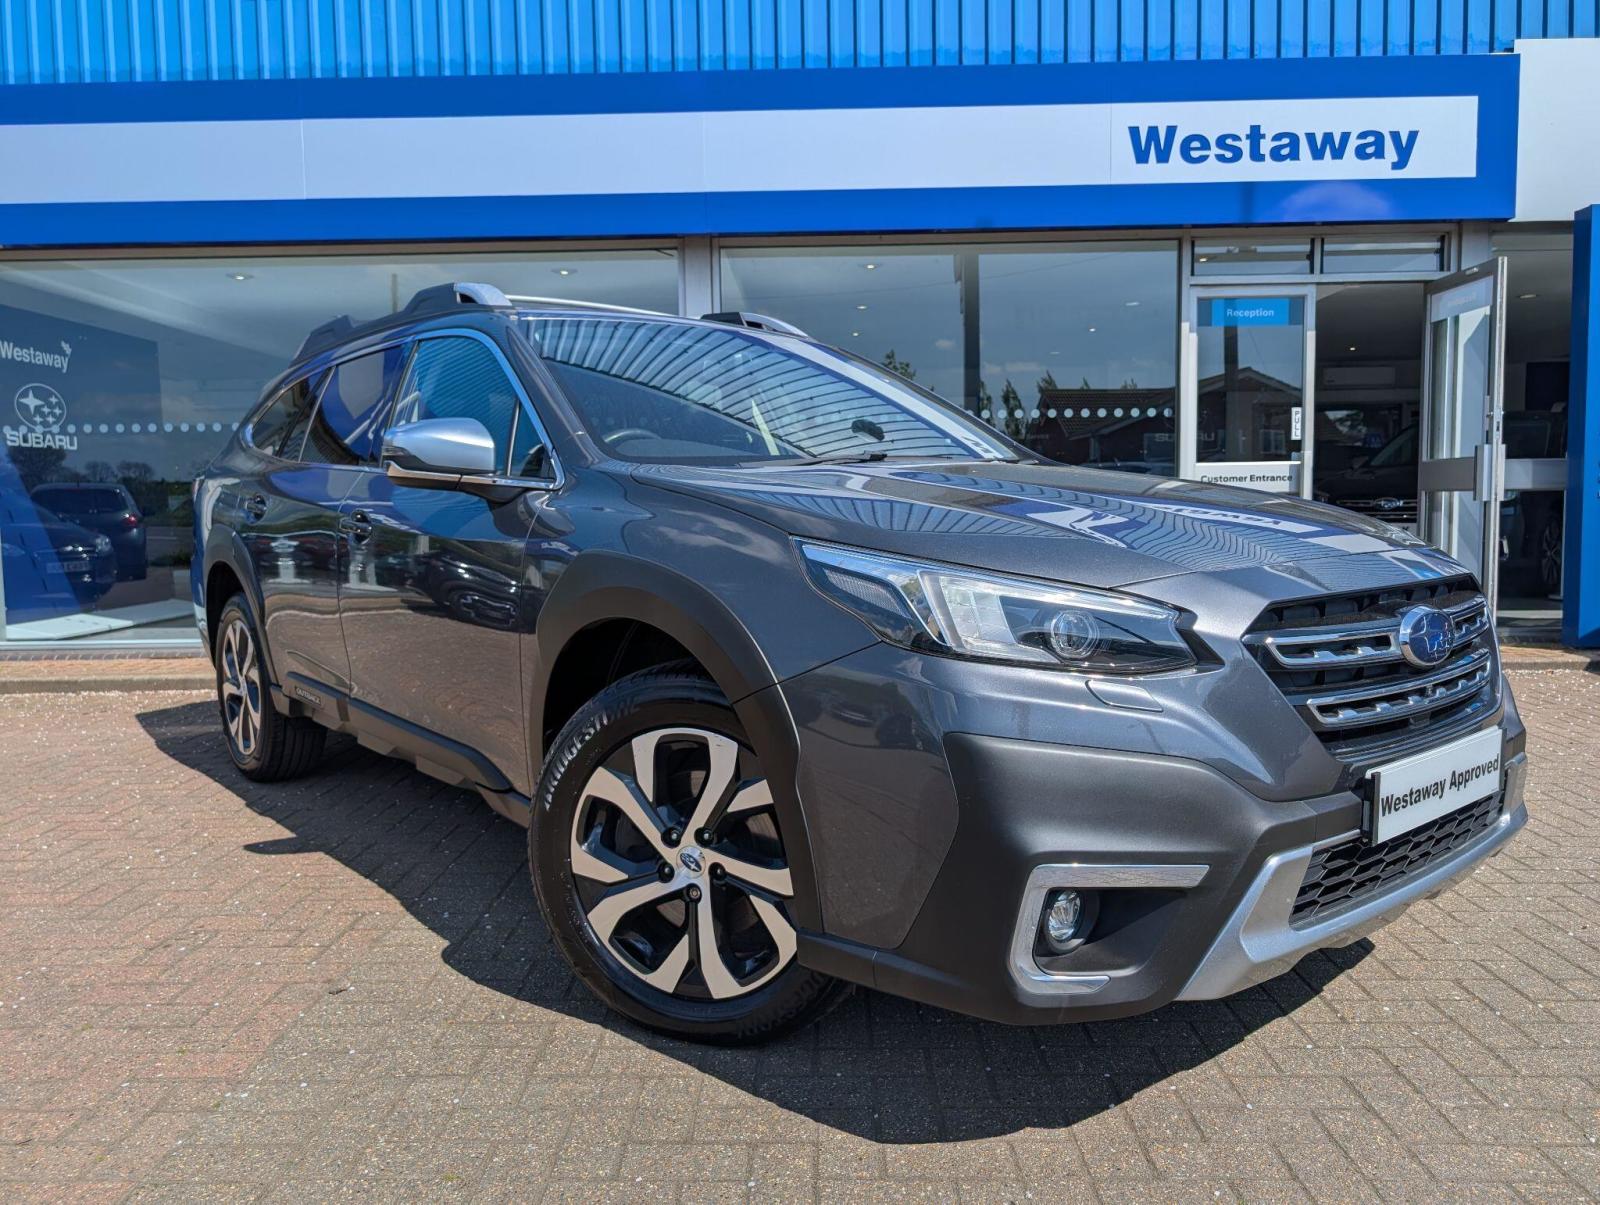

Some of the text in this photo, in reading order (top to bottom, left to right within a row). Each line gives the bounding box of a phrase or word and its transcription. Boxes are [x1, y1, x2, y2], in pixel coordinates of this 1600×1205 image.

[1128, 124, 1419, 171] Westaway
[1226, 308, 1275, 318] Reception
[0, 340, 69, 373] Westaway
[6, 430, 78, 451] SUBARU
[1200, 474, 1293, 483] Customer Entrance
[1381, 753, 1500, 817] Westaway Approved
